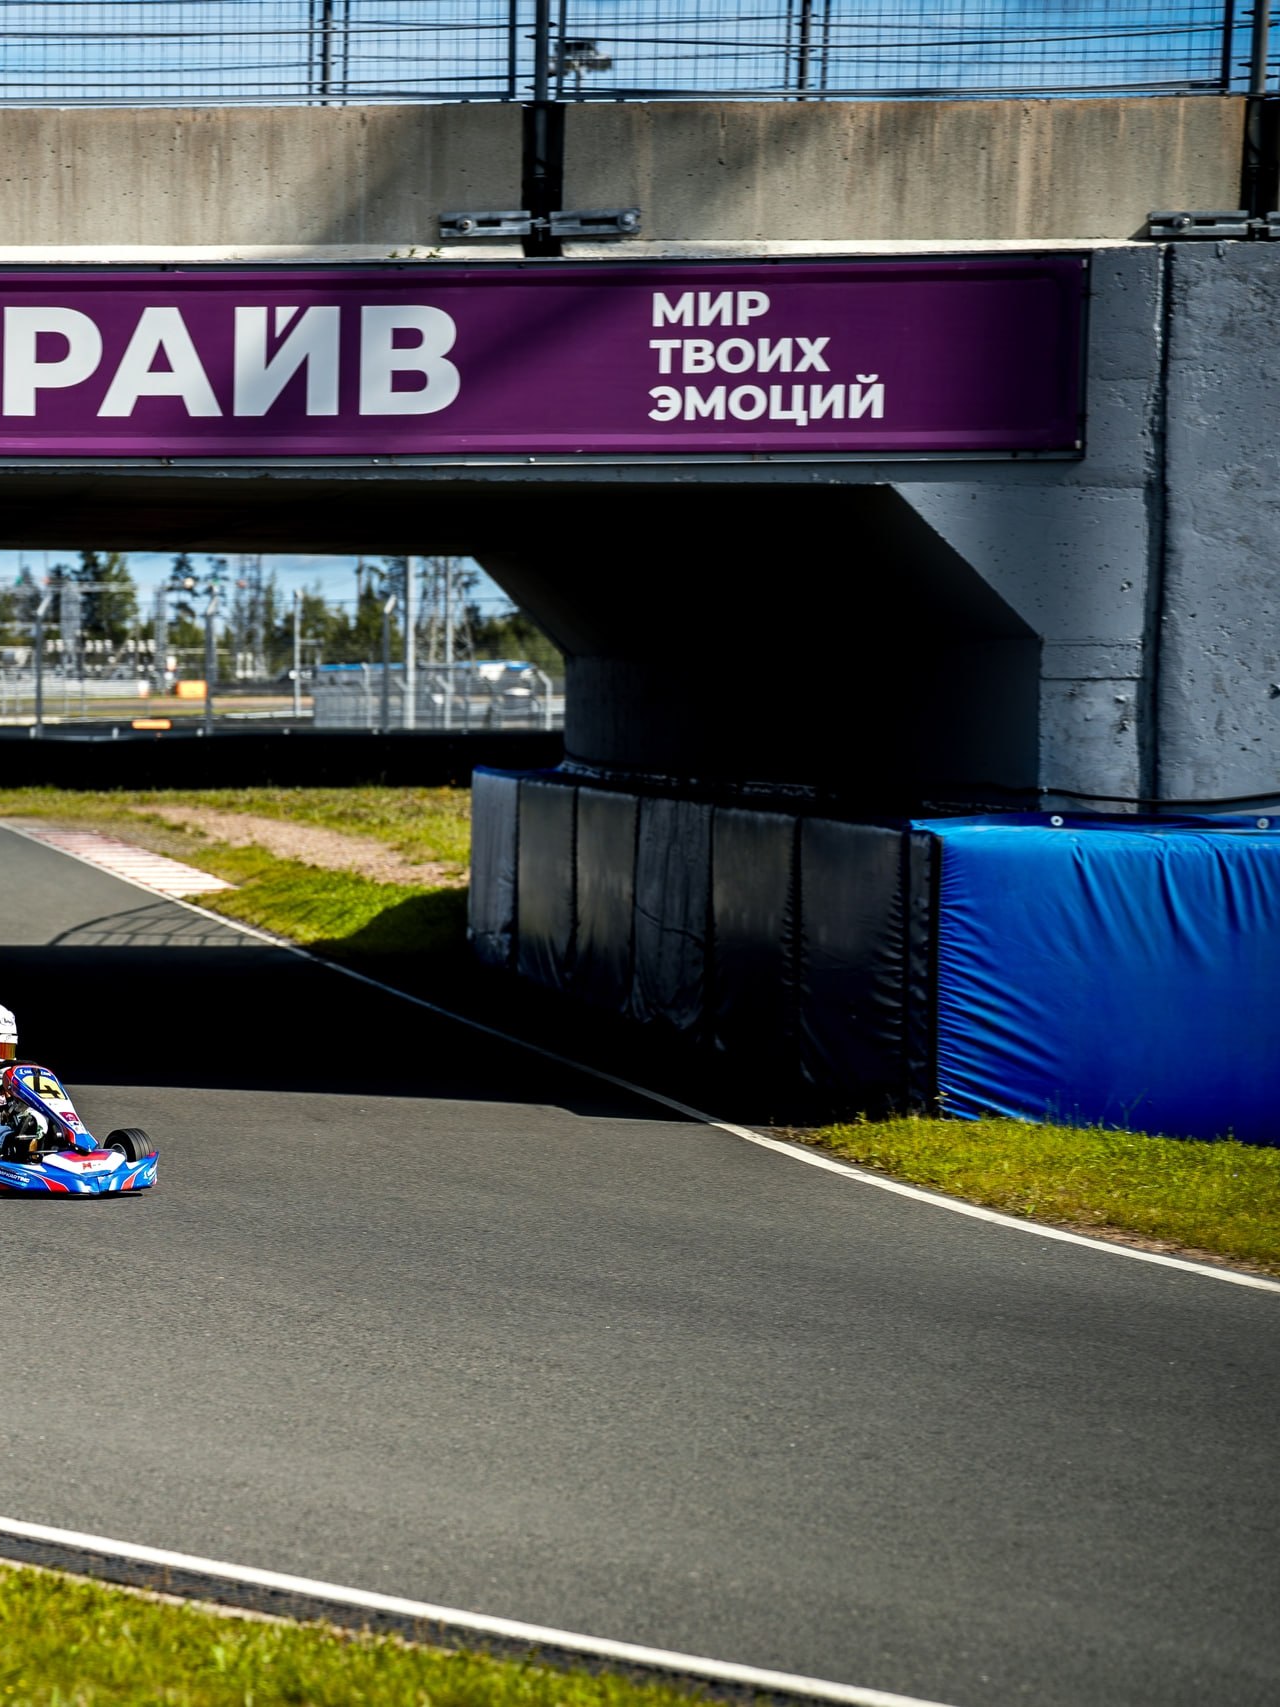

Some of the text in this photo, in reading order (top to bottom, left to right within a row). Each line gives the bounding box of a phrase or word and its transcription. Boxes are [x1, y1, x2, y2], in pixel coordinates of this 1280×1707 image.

[652, 290, 770, 327] МИР
[649, 336, 831, 374] ТВОИХ
[648, 373, 885, 426] ЭМОЦИЙ
[32, 1068, 61, 1099] 4
